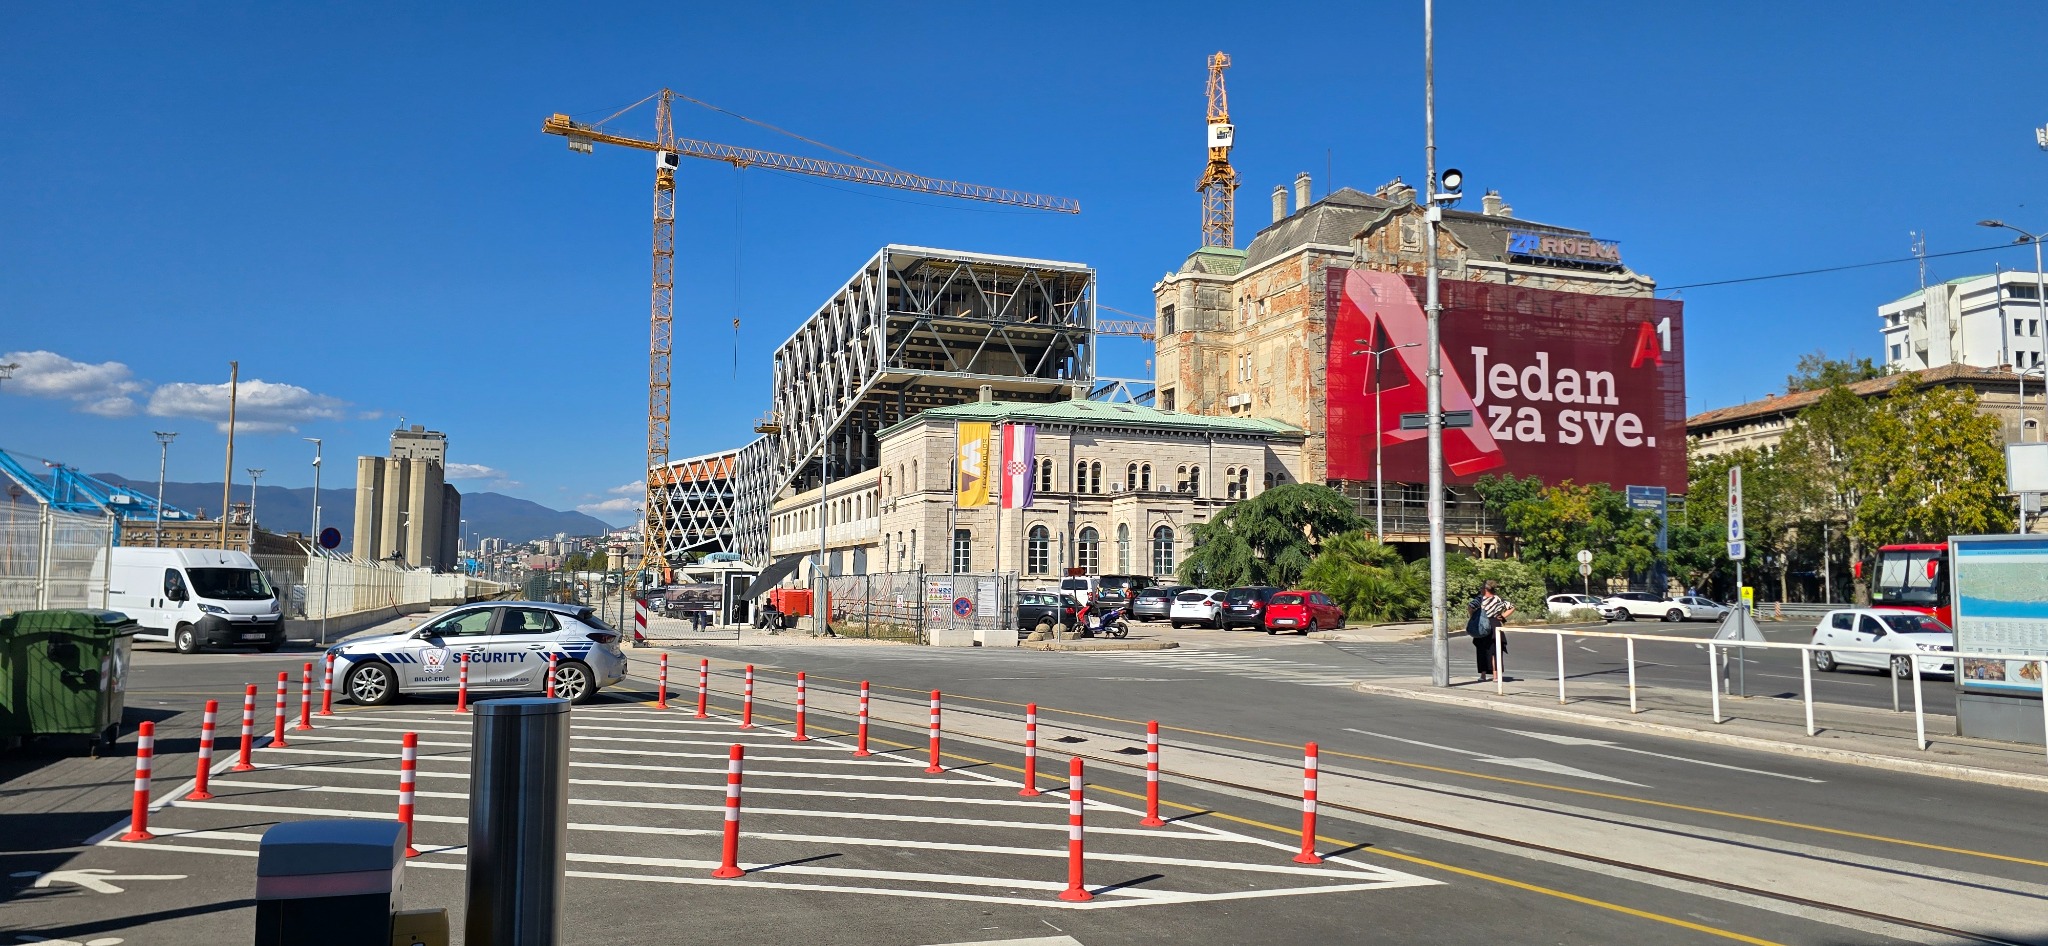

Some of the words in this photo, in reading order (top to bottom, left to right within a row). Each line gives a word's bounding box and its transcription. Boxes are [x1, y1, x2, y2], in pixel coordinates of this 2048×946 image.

[1541, 236, 1621, 260] RIJEKA
[1630, 317, 1671, 369] A1
[1471, 346, 1619, 407] Jedan
[1487, 404, 1546, 443] za
[1558, 408, 1656, 448] sve.
